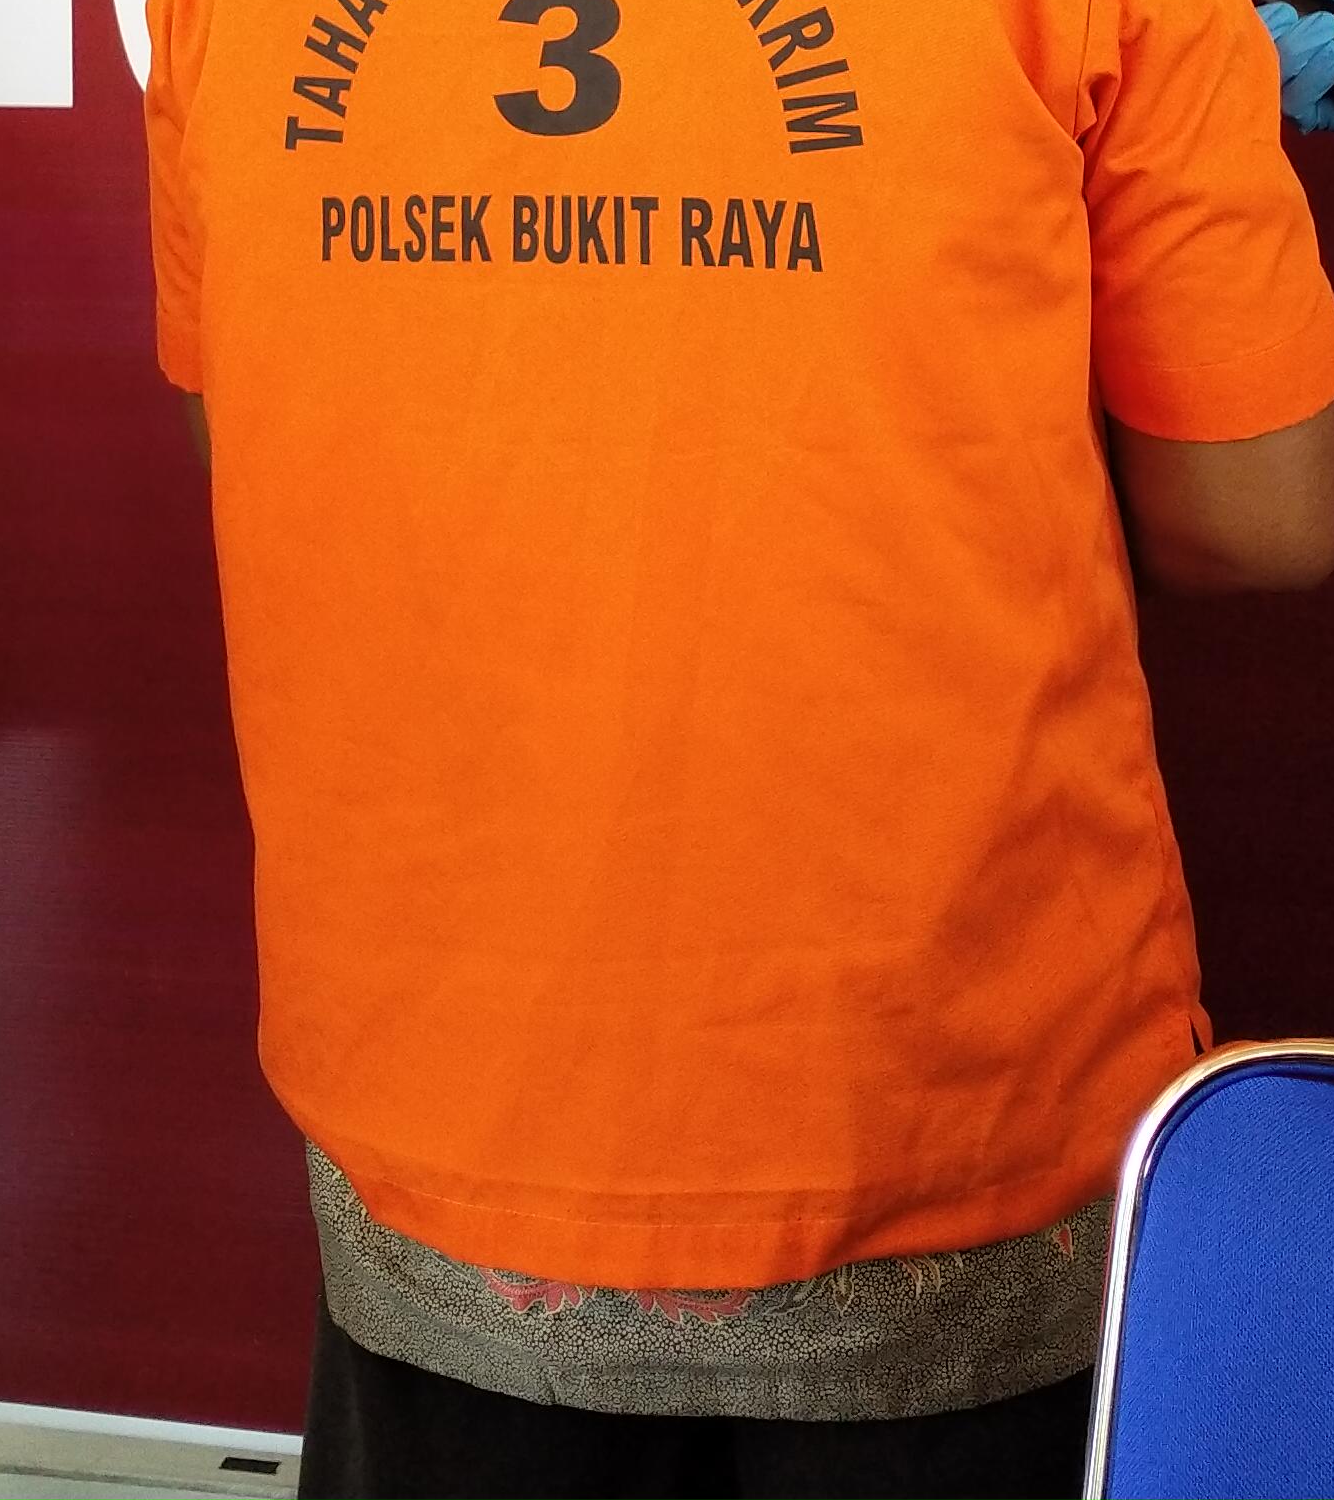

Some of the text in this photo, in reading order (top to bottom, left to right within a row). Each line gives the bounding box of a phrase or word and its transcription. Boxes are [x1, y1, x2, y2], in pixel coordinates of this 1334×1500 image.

[320, 194, 824, 273] POLSEK BUKIT RAYA
